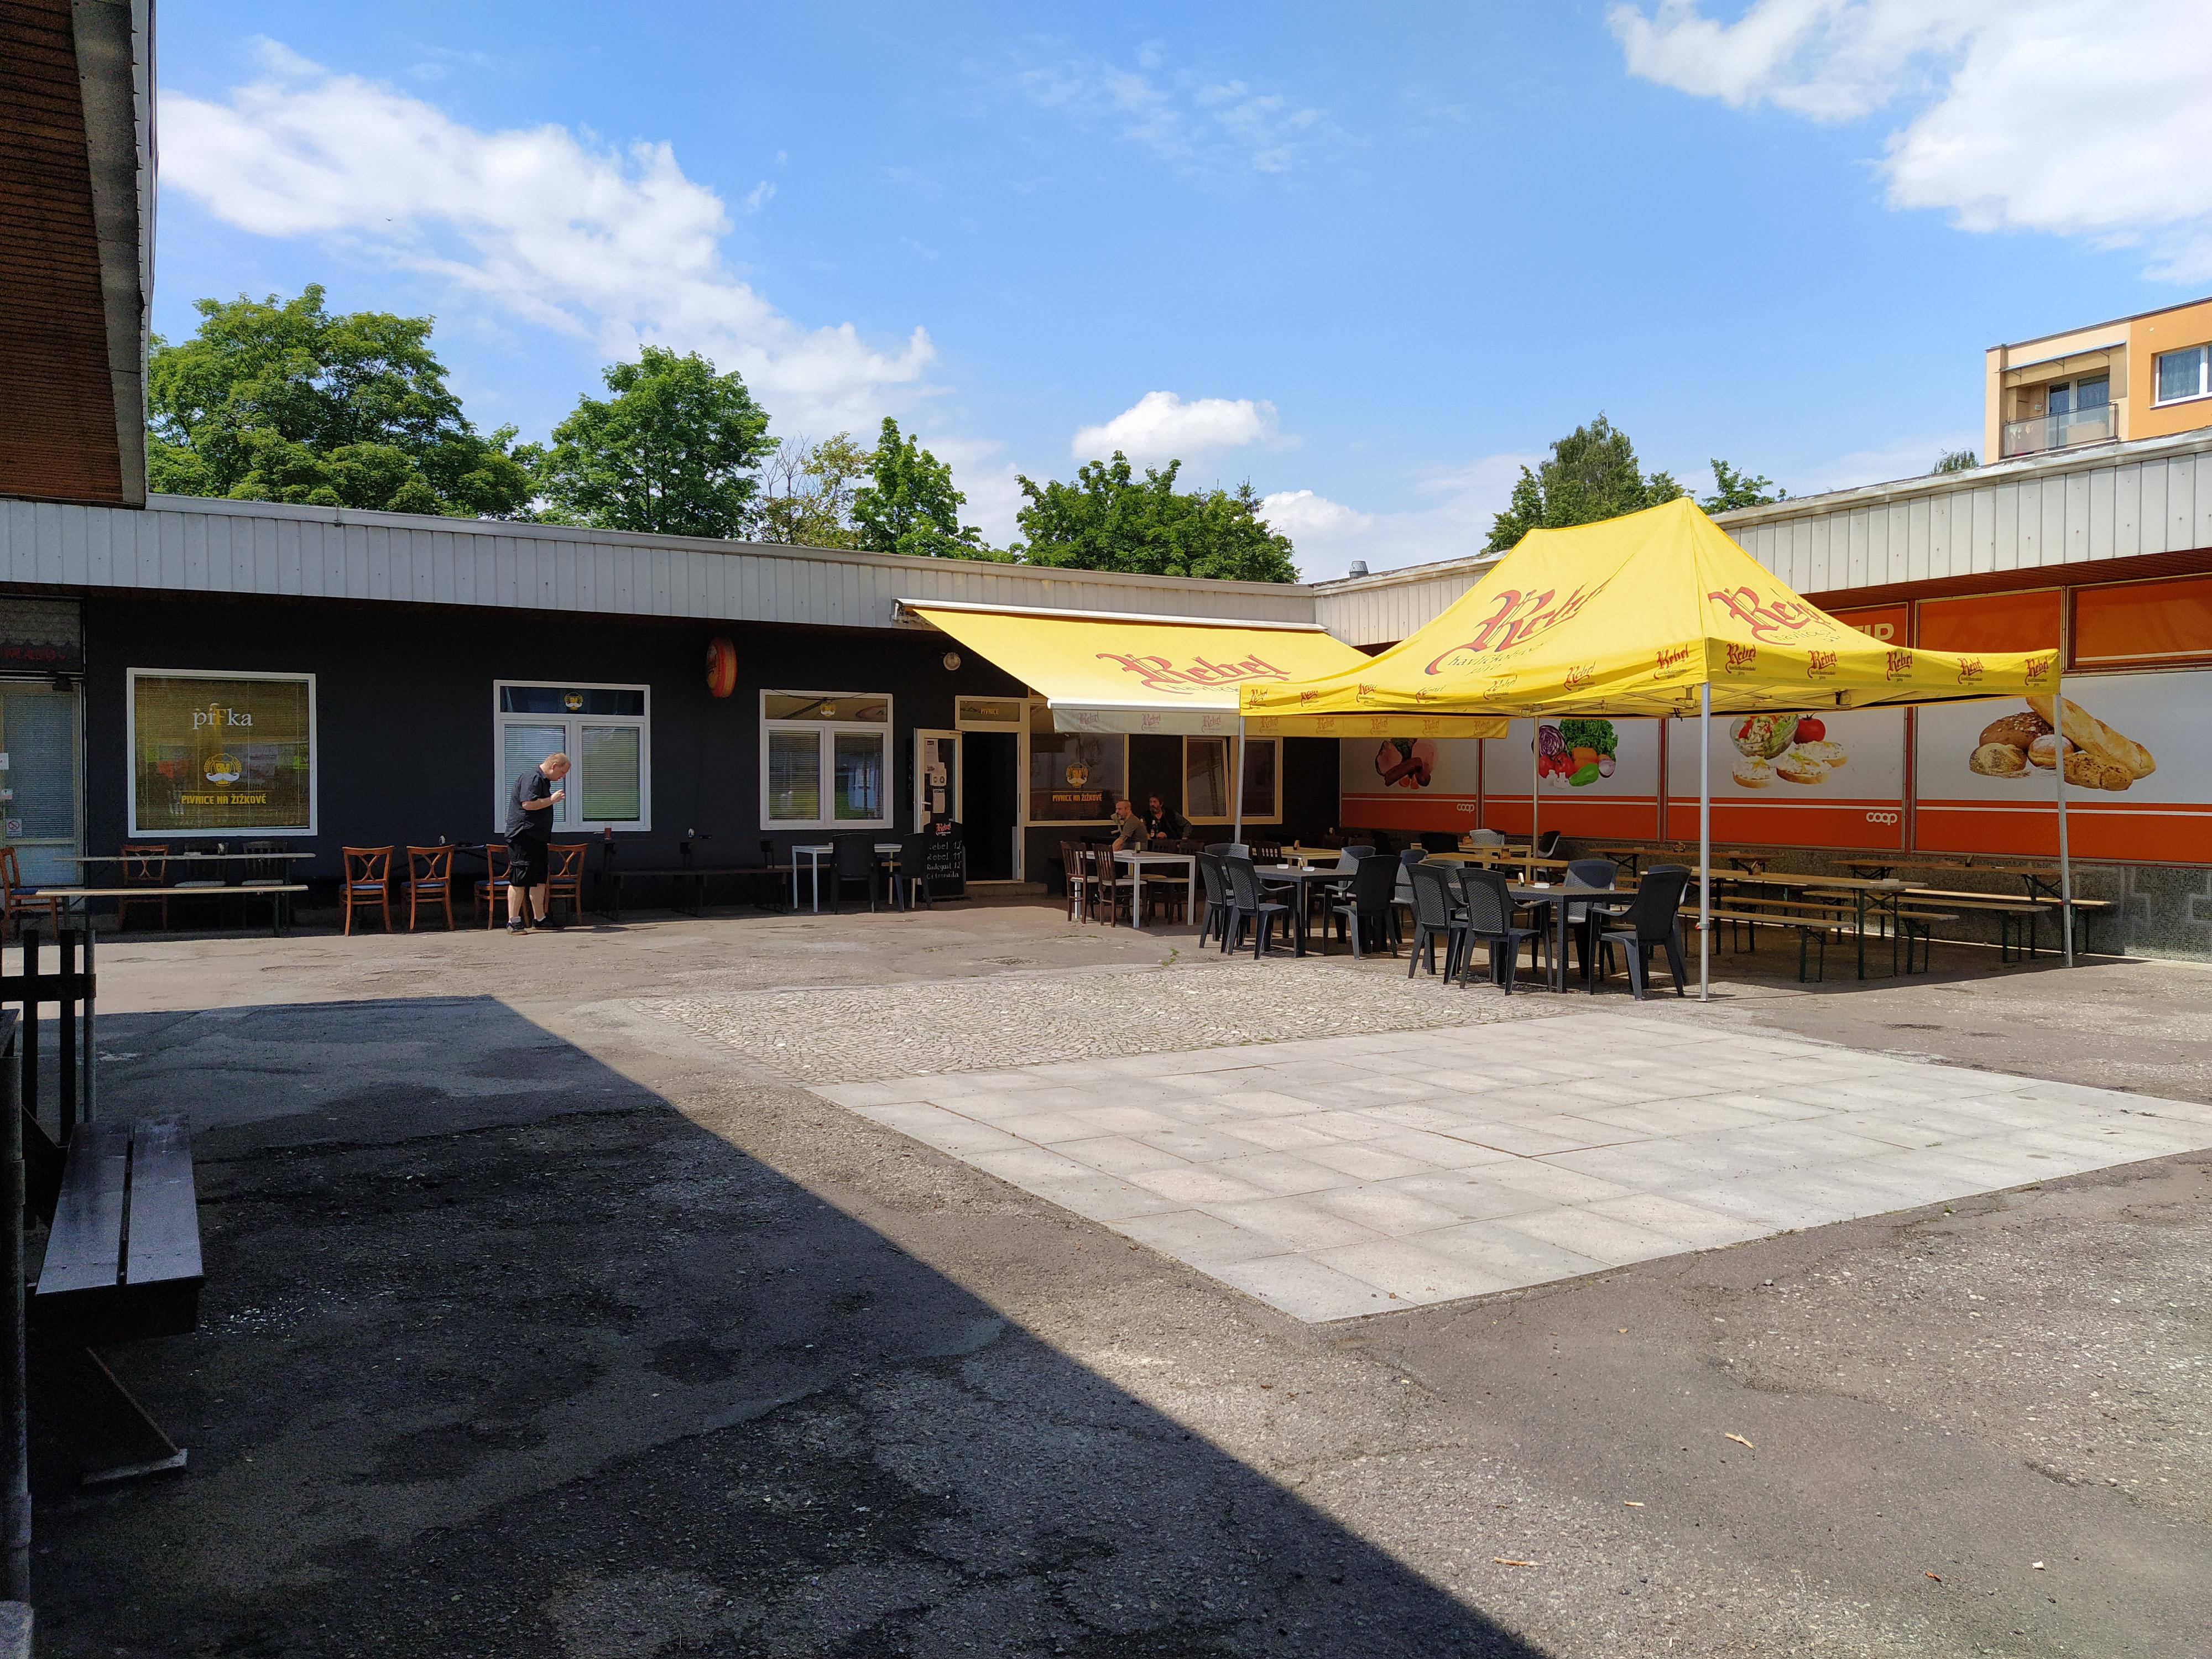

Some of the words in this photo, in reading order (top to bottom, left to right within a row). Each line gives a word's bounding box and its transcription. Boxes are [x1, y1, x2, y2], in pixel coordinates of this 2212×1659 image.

[1654, 644, 1689, 680] Rebel
[1725, 643, 1756, 674] Rebel
[1807, 650, 1838, 679] Rebel
[1886, 650, 1913, 681] Rebel
[1957, 657, 1985, 684] Rebel
[2025, 656, 2049, 686] Rebel
[1095, 653, 1291, 695] Rebel
[1563, 661, 1596, 691] Rebel
[1141, 713, 1161, 731] Rebel
[1202, 714, 1222, 732] Rebel
[181, 796, 214, 805] PIVNICE
[217, 795, 228, 804] NA
[231, 793, 267, 804] ŽIŽKOVÉ
[1457, 804, 1475, 814] coop
[935, 822, 952, 836] Rebel
[1866, 812, 1898, 826] coop
[927, 852, 948, 860] Rebel
